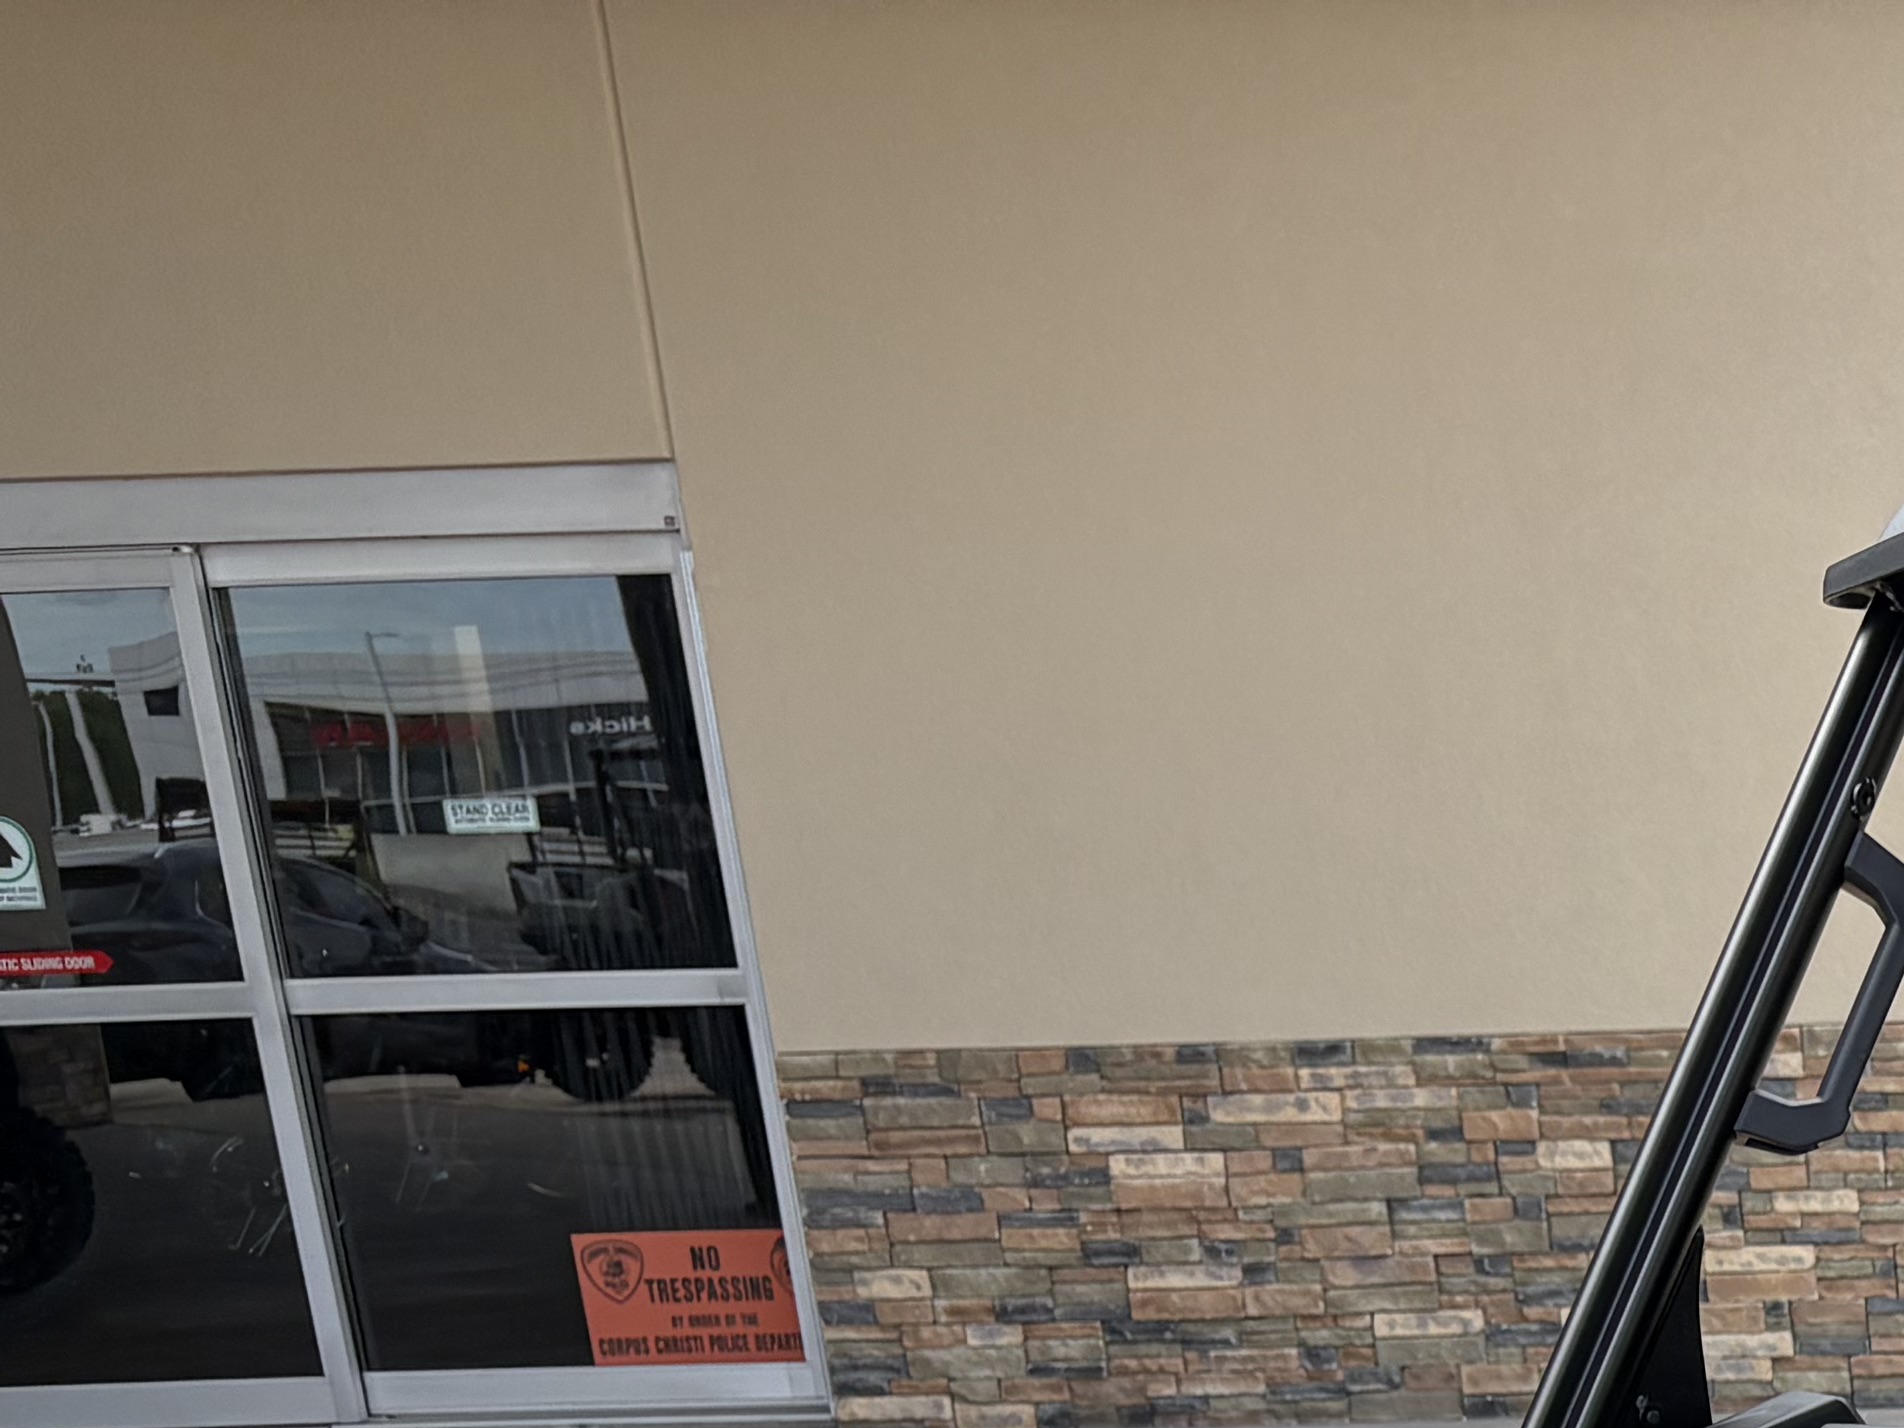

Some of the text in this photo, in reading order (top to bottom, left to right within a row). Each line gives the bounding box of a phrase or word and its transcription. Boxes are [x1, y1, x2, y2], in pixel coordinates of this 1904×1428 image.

[690, 1245, 721, 1272] NO
[644, 1275, 775, 1304] TRESPASSING
[598, 1331, 802, 1357] CORPUS CHRISTI POLICE DEPART
